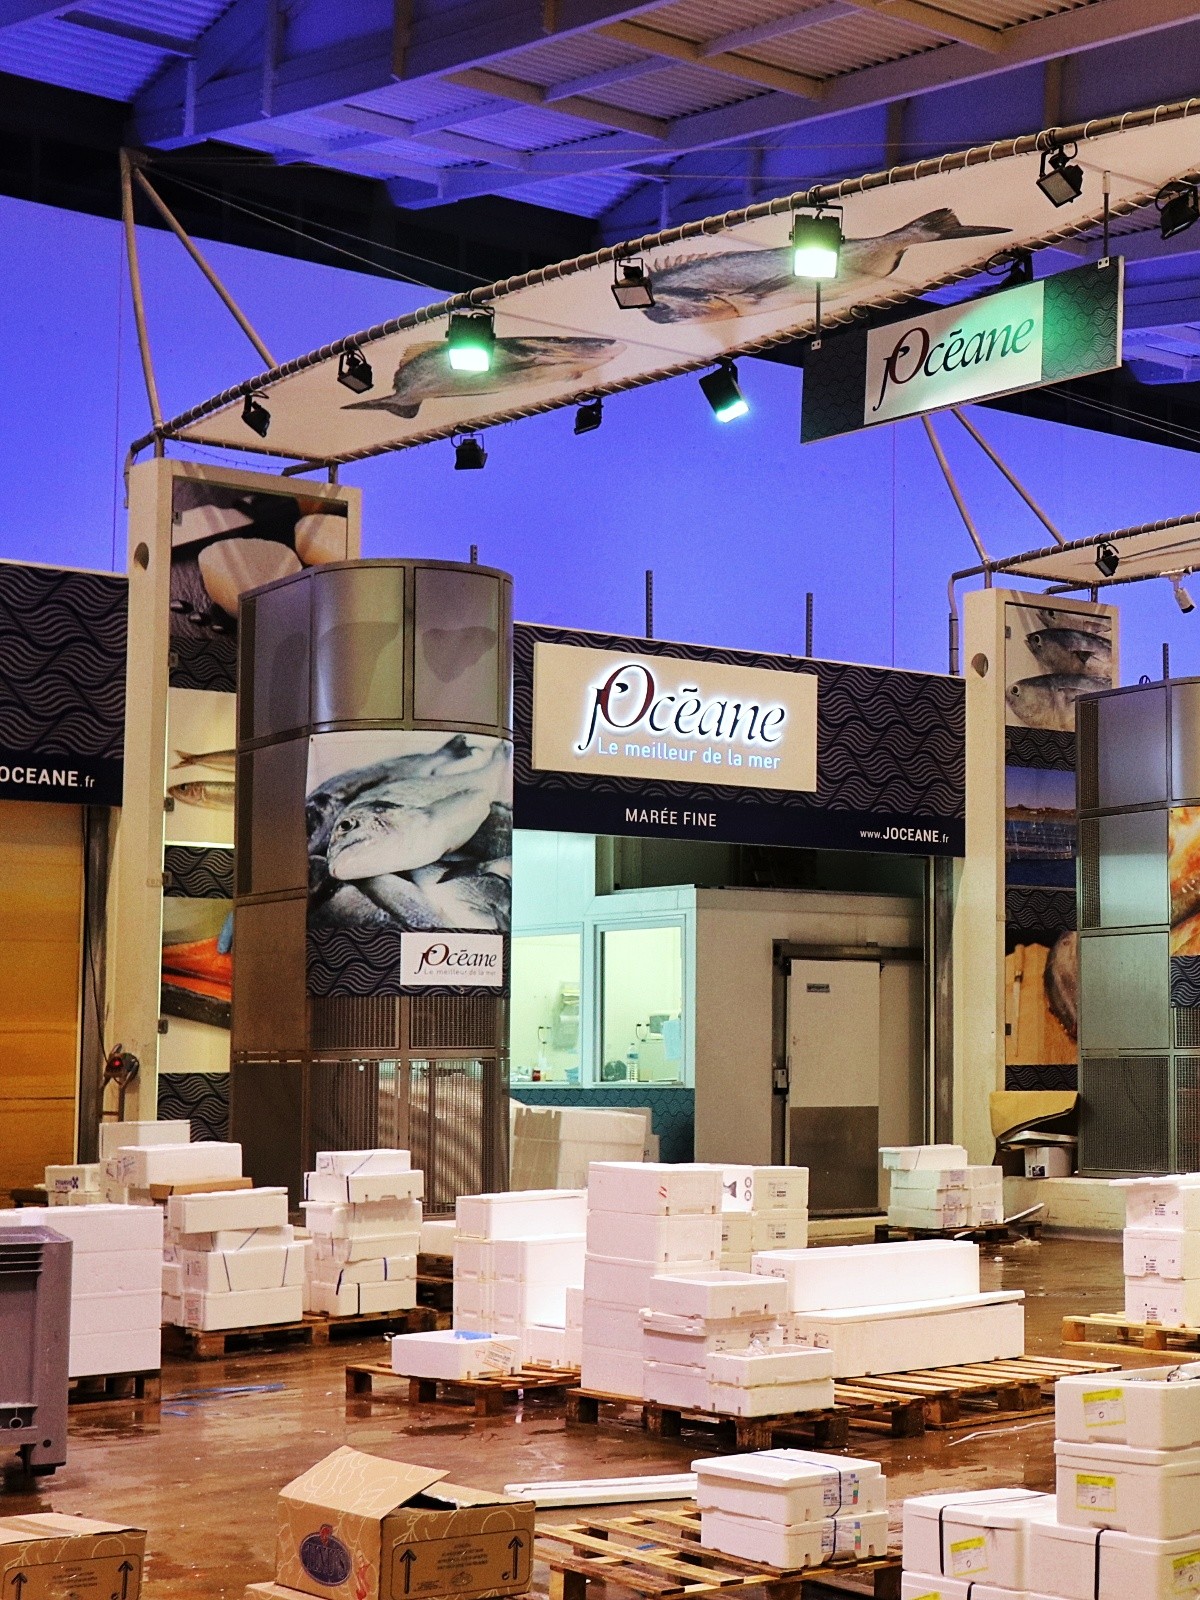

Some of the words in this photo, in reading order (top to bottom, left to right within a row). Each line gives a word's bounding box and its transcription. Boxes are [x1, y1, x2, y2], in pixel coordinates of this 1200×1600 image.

[598, 737, 618, 755] Le
[625, 742, 697, 762] meilleur
[703, 746, 722, 765] de
[728, 748, 742, 767] la
[749, 755, 781, 770] mer
[625, 808, 678, 825] MARÉE
[683, 812, 717, 827] FINE
[860, 827, 949, 843] www.JOCEANE.fr
